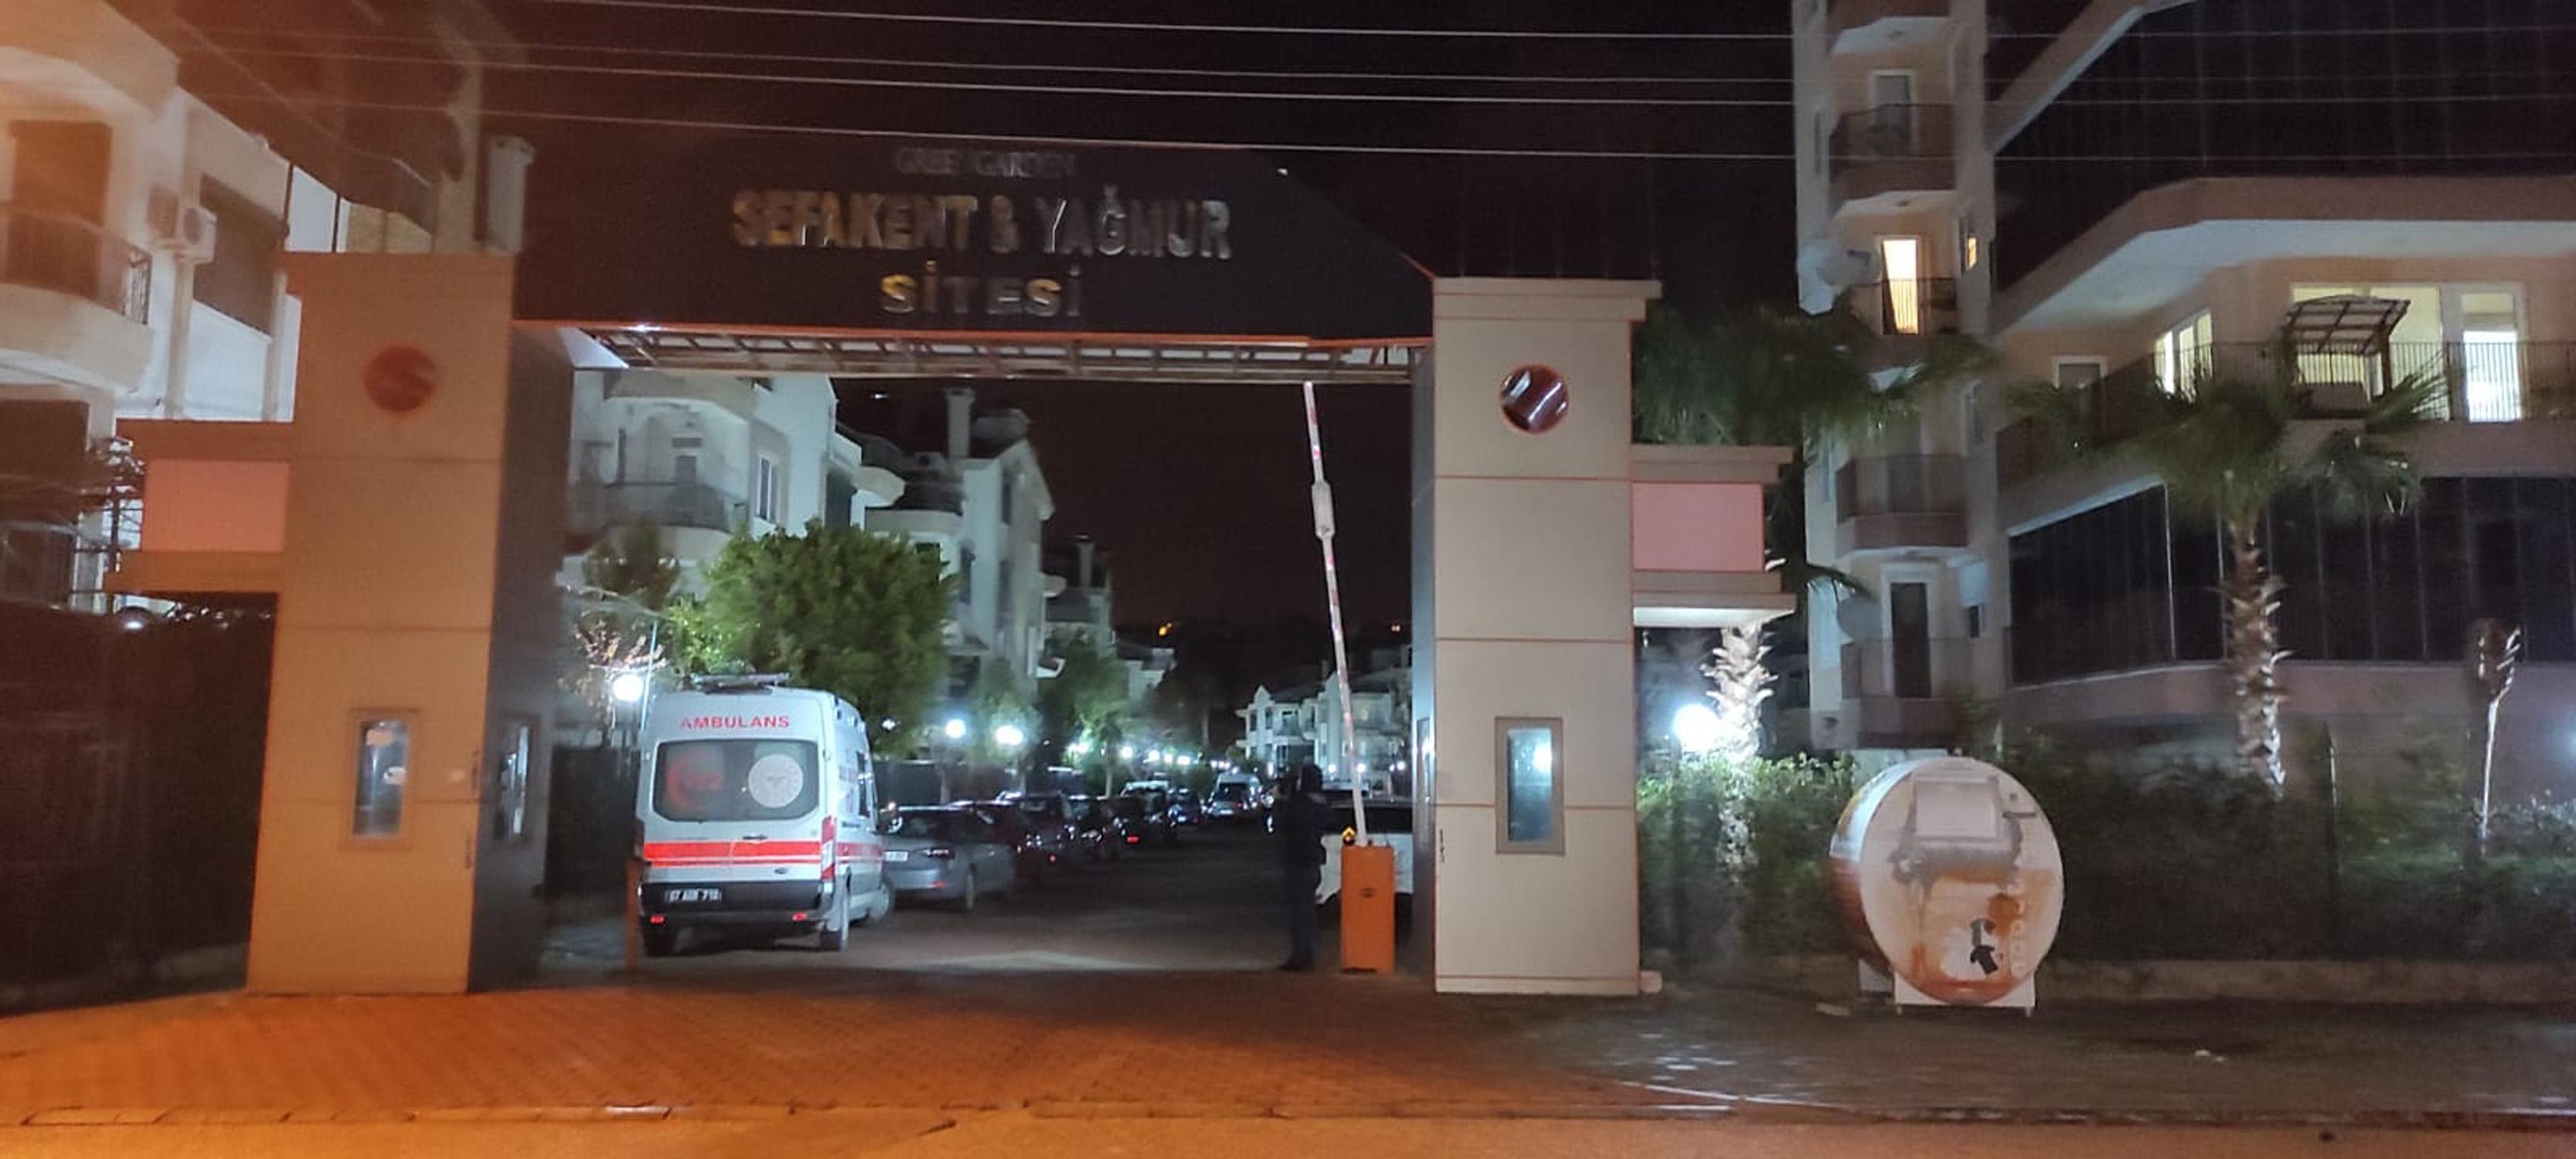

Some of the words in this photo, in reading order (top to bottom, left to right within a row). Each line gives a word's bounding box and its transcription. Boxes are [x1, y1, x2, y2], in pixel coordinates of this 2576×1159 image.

[732, 190, 978, 247] SEFAKENT
[992, 195, 1019, 253] &
[1036, 184, 1232, 260] YAĞMUR
[880, 261, 1080, 318] SİTESİ
[680, 714, 790, 730] AMBULANS
